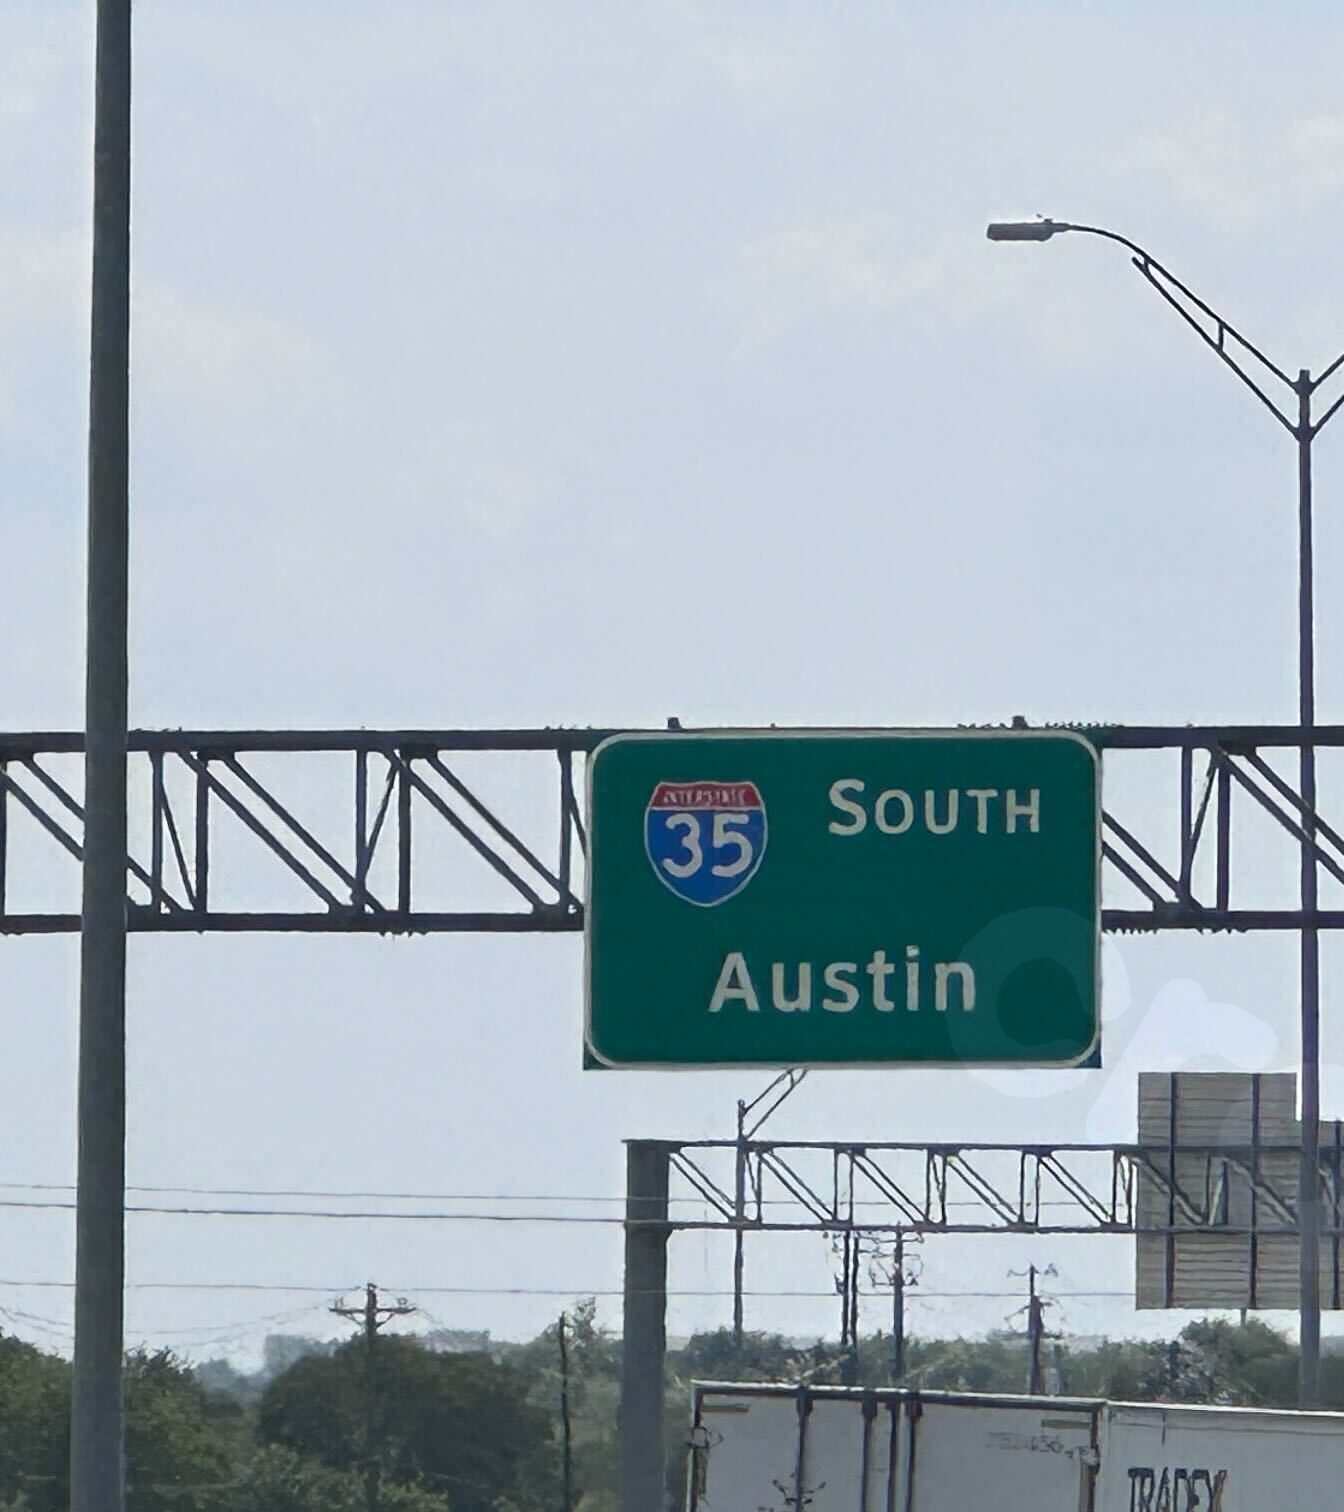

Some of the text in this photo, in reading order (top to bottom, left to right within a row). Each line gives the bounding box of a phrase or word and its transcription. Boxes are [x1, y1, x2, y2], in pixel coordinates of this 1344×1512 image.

[829, 779, 1039, 835] SOUTH
[662, 813, 753, 878] 35
[709, 946, 976, 1012] Austin
